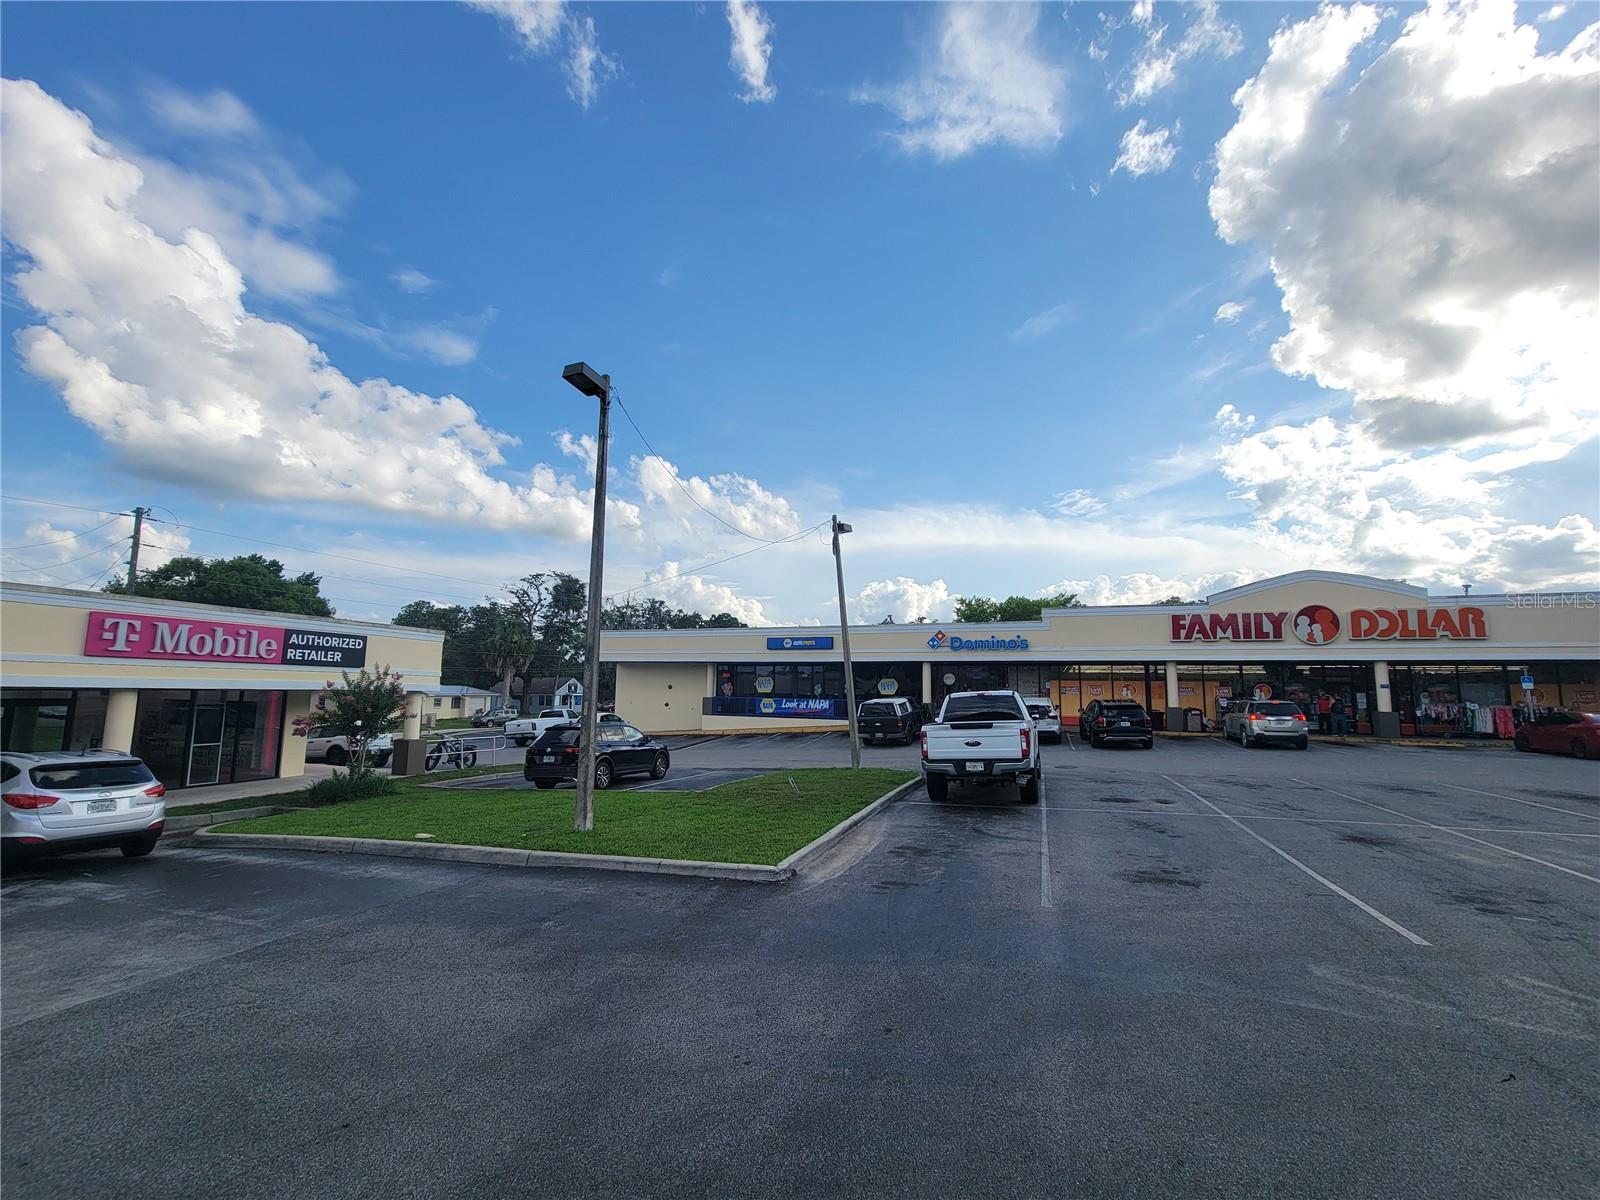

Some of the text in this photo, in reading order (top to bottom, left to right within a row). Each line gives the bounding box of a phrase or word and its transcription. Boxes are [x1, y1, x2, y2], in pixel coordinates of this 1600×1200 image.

[1171, 607, 1487, 641] FAMILY DOLLAR
[152, 622, 278, 659] Mobile
[288, 633, 363, 649] AUTHORIZED
[950, 635, 1029, 651] Domino's
[286, 649, 342, 662] RETAILER
[782, 698, 830, 710] Look at NAPA
